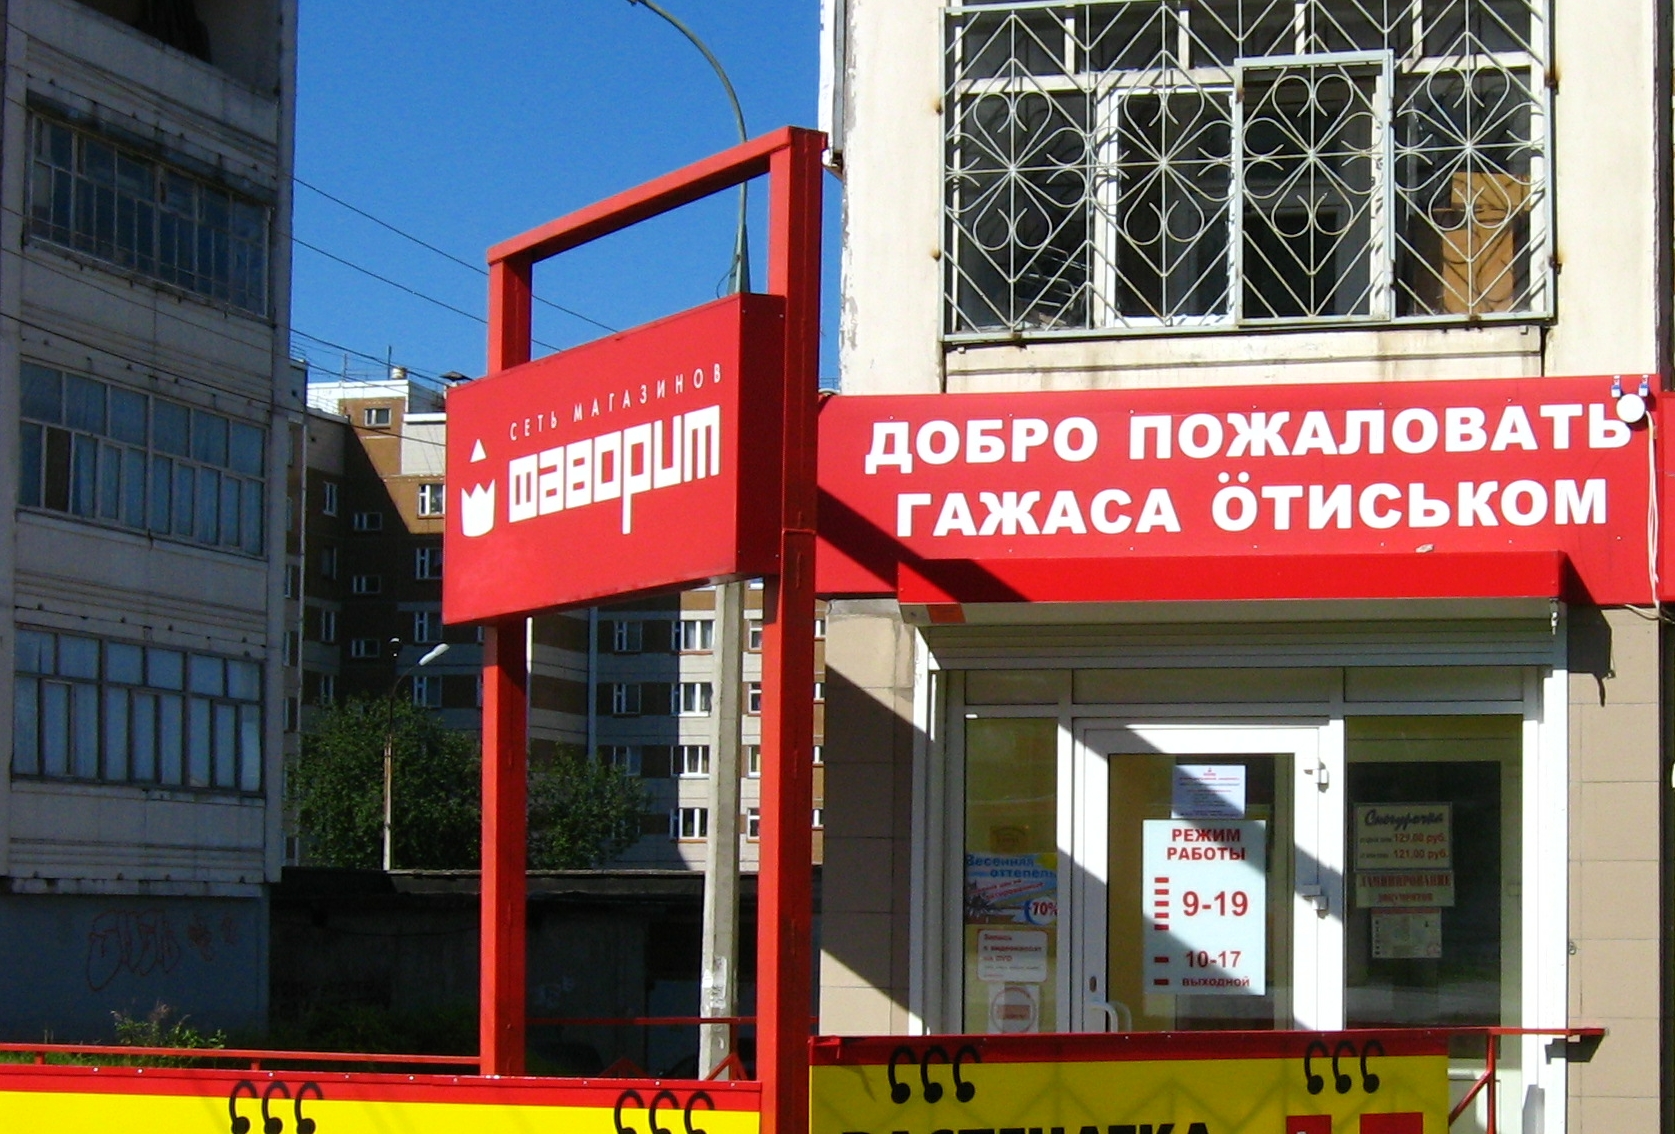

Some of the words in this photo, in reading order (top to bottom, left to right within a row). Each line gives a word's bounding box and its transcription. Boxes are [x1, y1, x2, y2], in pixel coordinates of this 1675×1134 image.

[509, 411, 559, 441] СЕТЬ
[573, 363, 721, 422] МАГАЗИНОВ
[864, 416, 1099, 475] ДОБРО
[1129, 402, 1632, 460] ПОЖАЛОВАТЬ
[896, 488, 1182, 537] ГАЖАСА
[1211, 471, 1607, 532] ӦТИСЬКОМ
[1172, 828, 1241, 842] РЕЖИМ
[1167, 846, 1246, 861] РАБОТЫ
[1182, 891, 1249, 917] 9-19
[1185, 951, 1241, 968] 10-17
